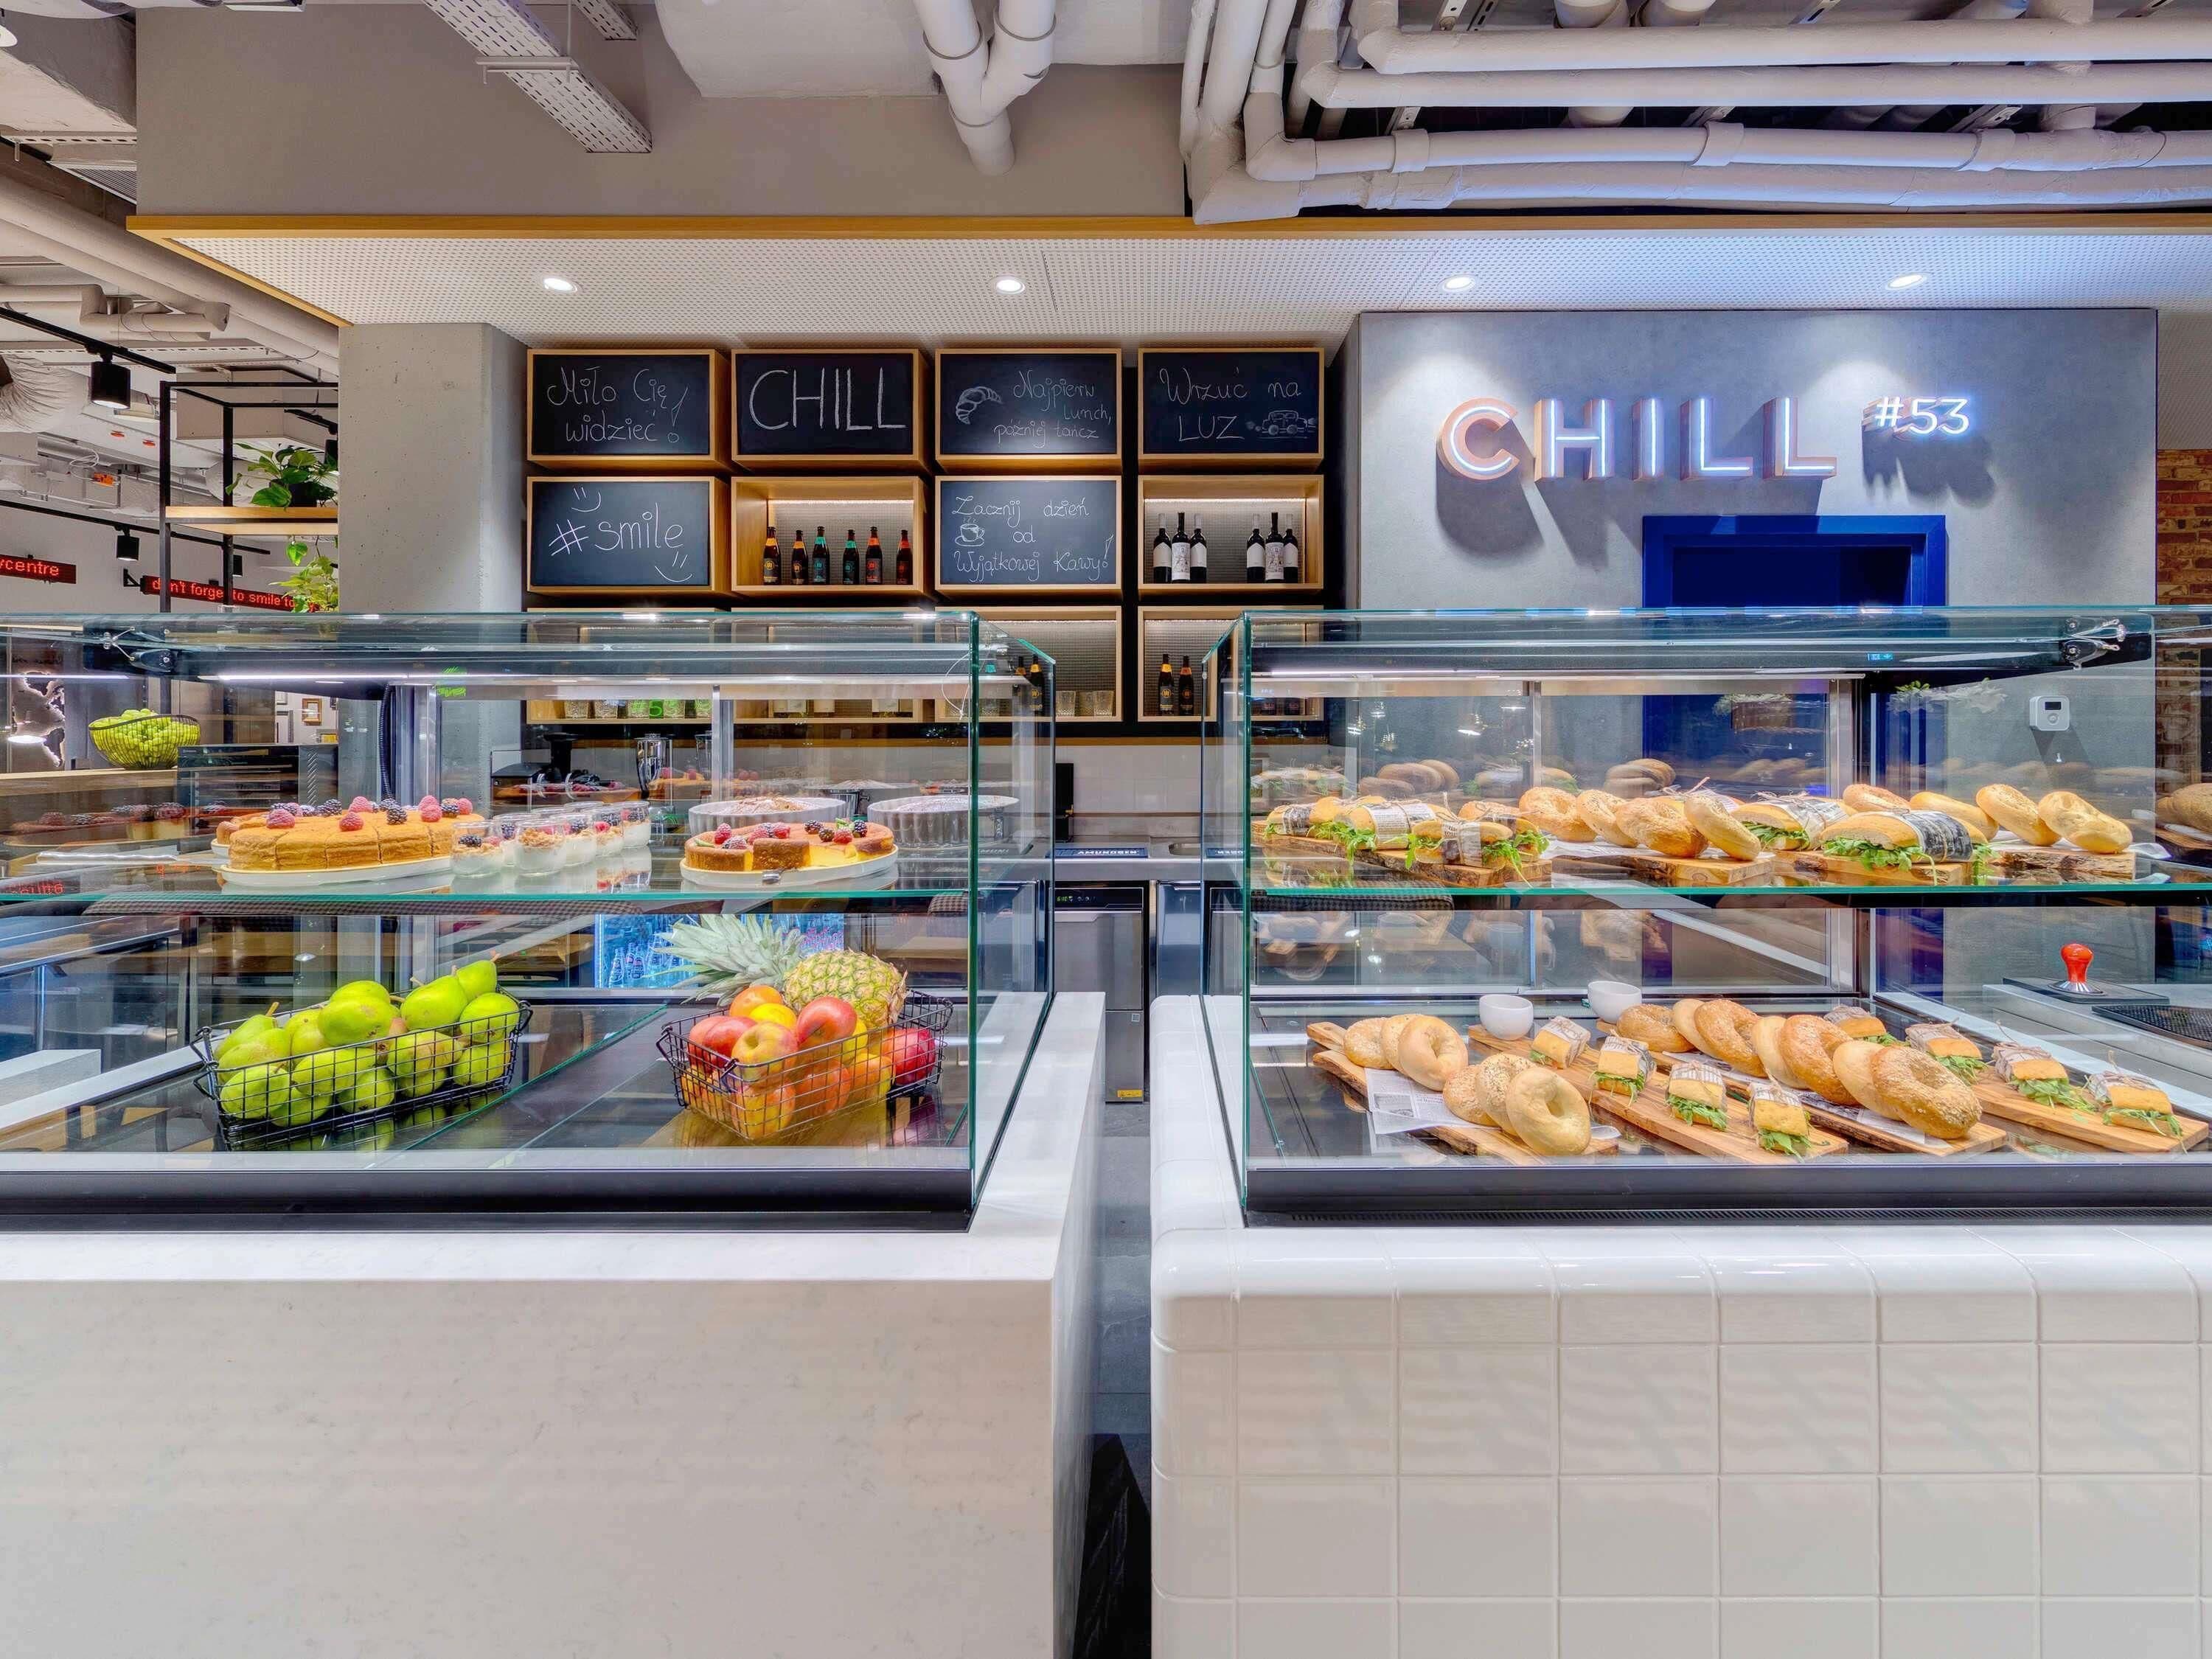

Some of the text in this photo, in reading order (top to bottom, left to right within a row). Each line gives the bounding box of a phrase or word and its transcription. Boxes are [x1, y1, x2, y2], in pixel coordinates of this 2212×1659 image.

[633, 368, 667, 408] Cię
[748, 366, 906, 431] CHILL
[1267, 380, 1302, 399] na
[1178, 413, 1245, 442] LUZ
[1870, 394, 1971, 436] #53
[1436, 397, 1838, 481] CHILL
[951, 495, 1021, 529] Zacznij
[1012, 524, 1036, 543] od
[153, 577, 186, 594] dn't
[232, 590, 244, 601] to
[248, 593, 280, 605] smile
